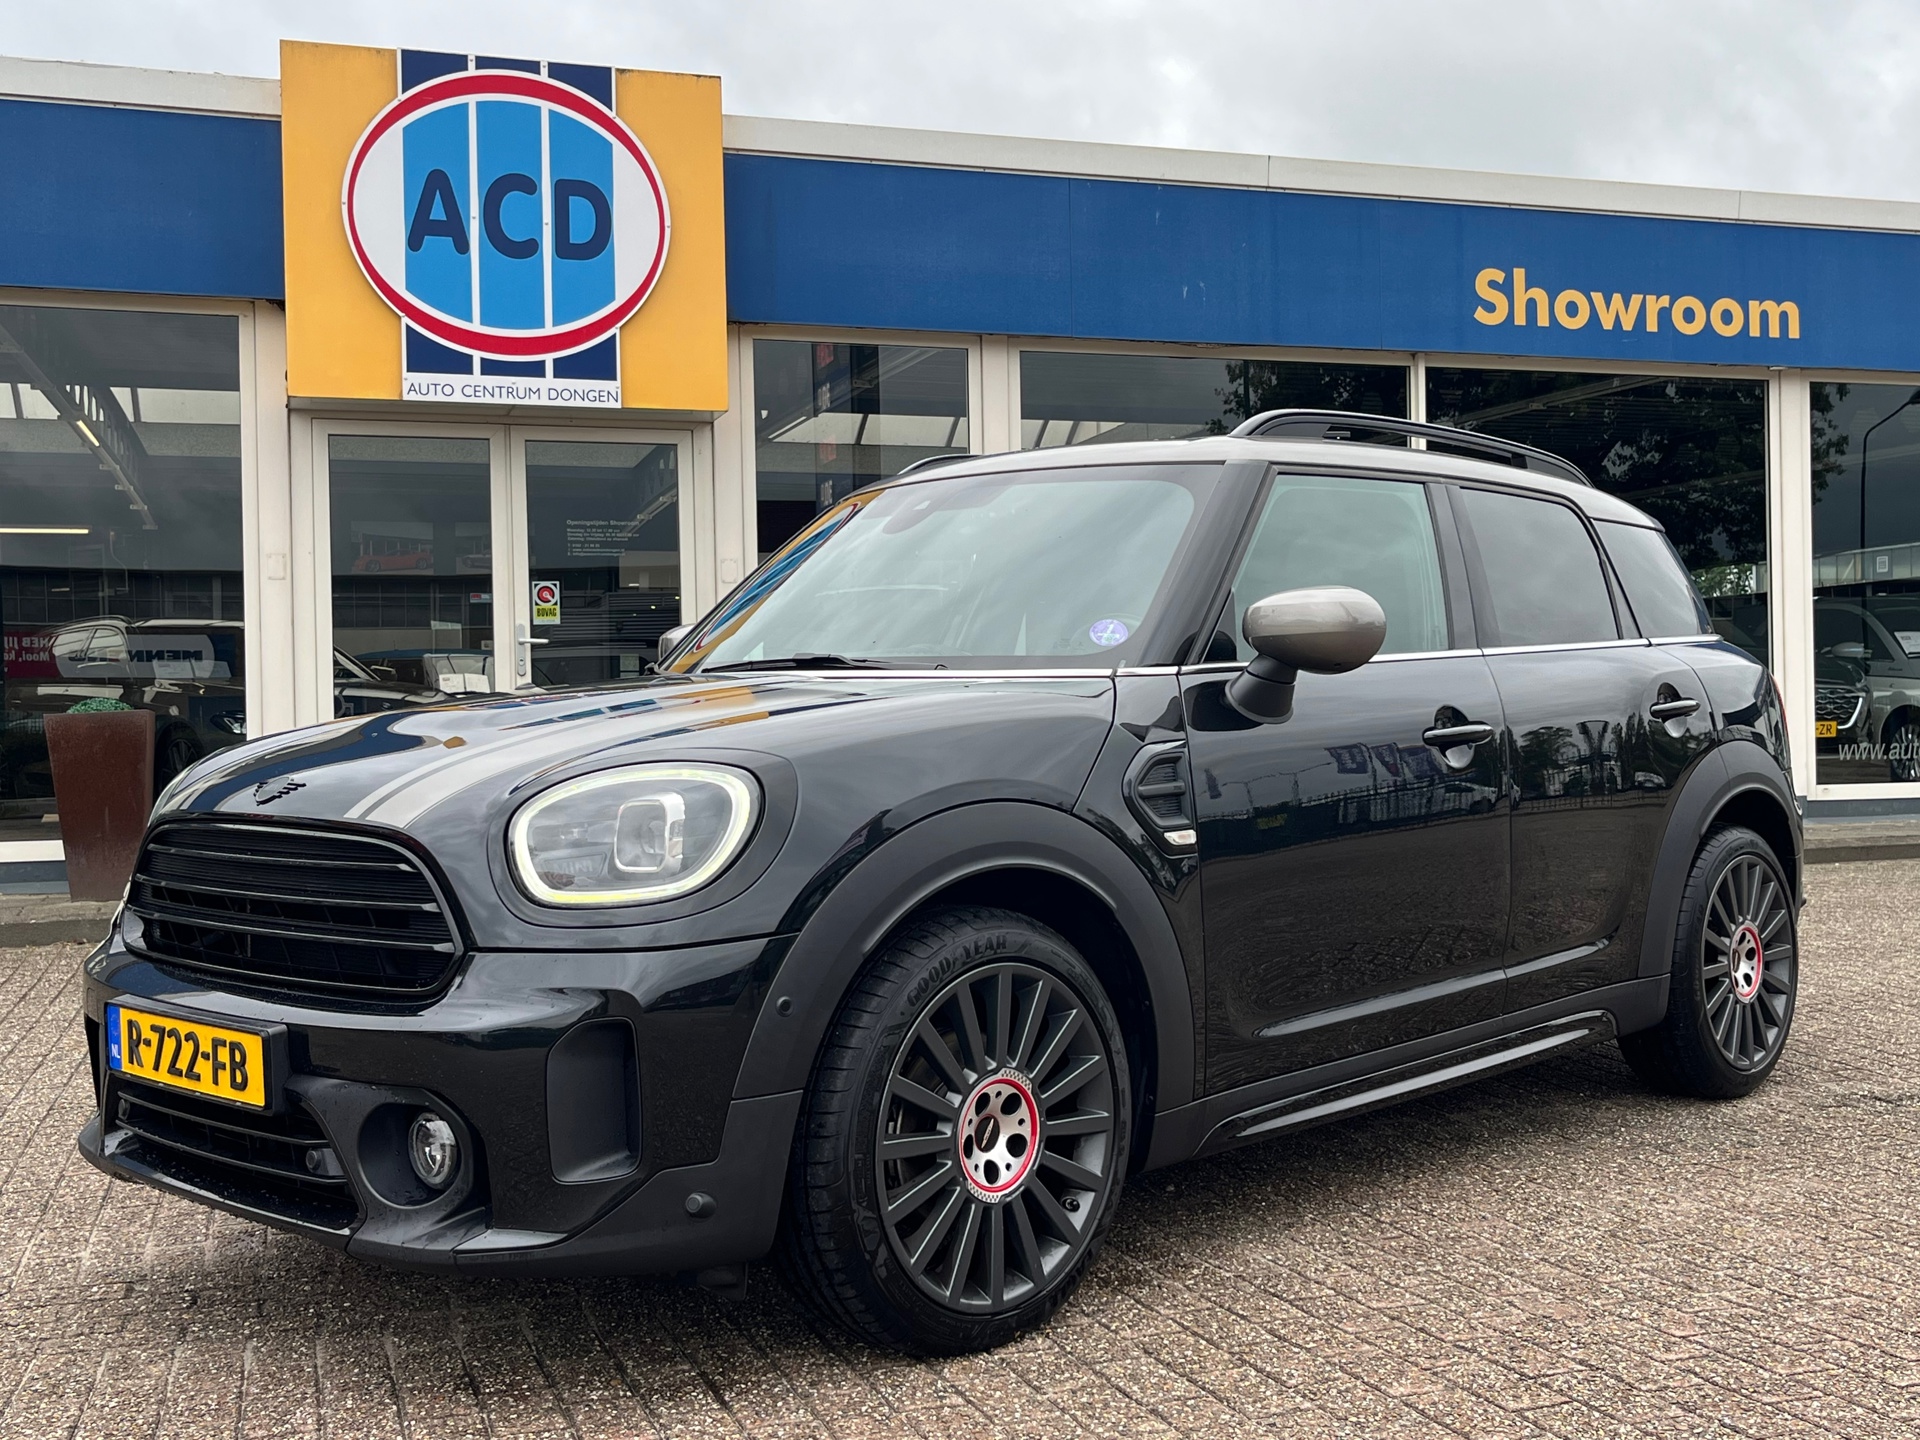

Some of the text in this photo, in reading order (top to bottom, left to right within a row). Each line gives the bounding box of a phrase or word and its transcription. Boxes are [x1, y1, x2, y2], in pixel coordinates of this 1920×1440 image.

[407, 168, 612, 261] ACD
[1473, 267, 1800, 339] Showroom
[407, 382, 619, 403] AUTO CENTRUM DONGEN
[537, 607, 557, 618] BOVAG
[111, 1043, 121, 1059] NL
[127, 1019, 249, 1092] R-722-FB
